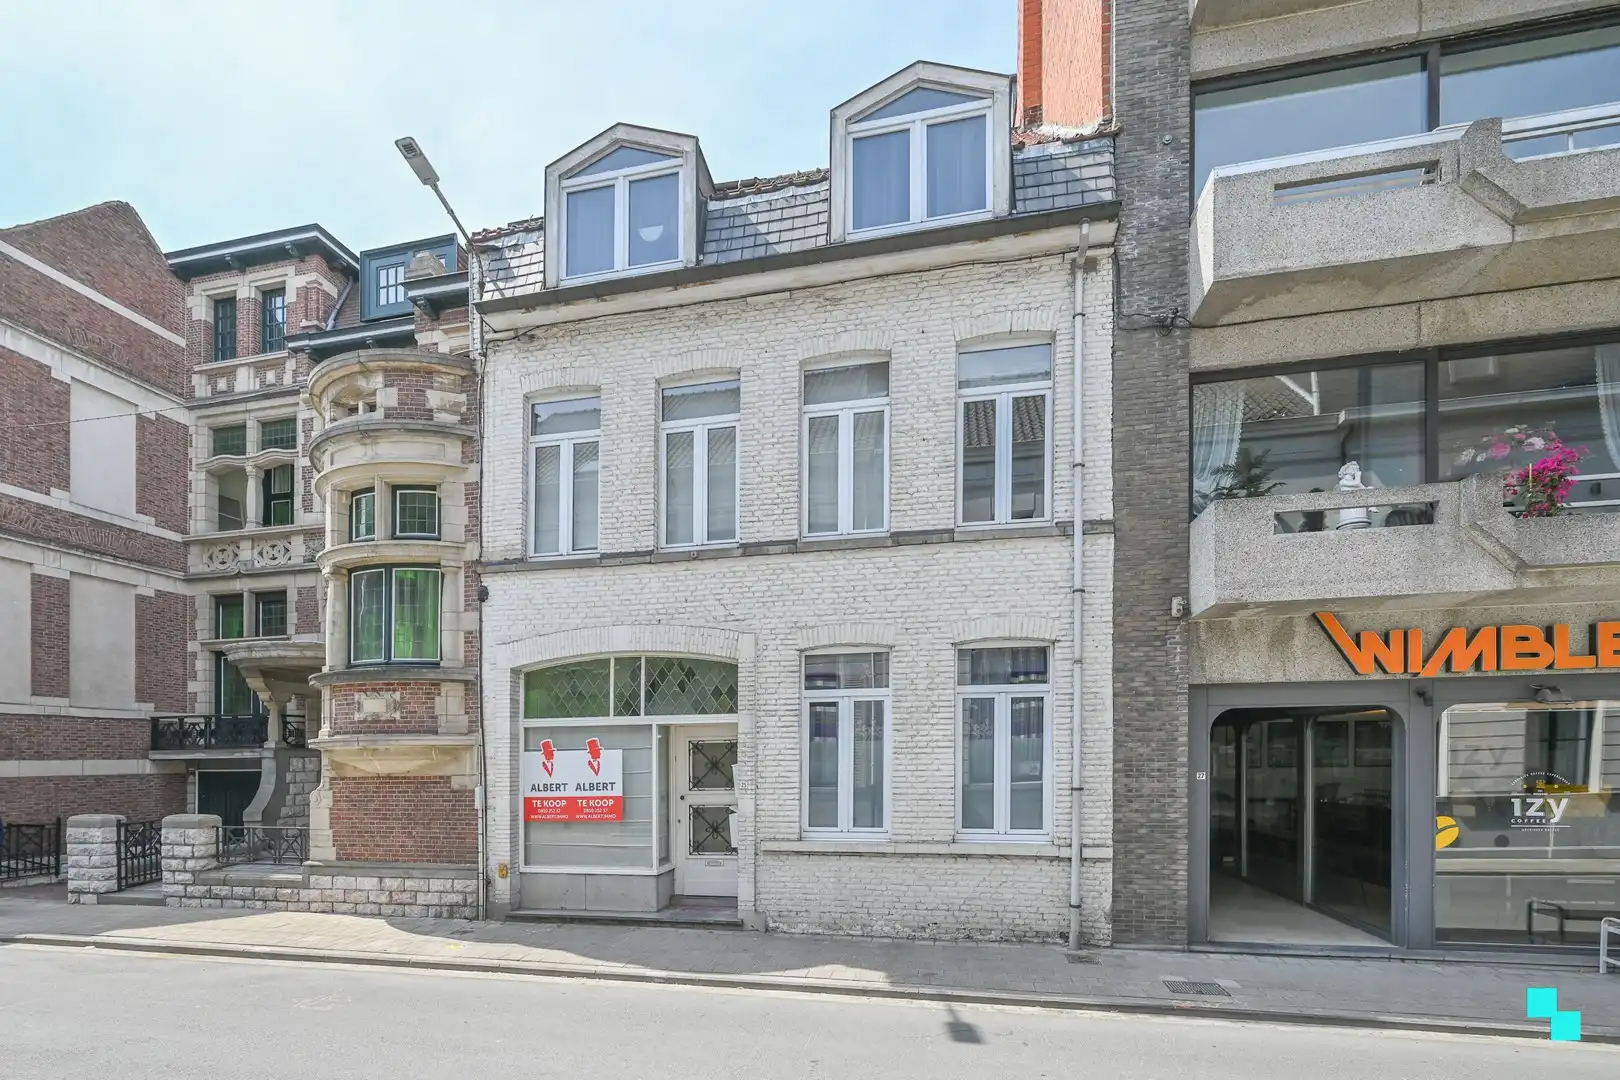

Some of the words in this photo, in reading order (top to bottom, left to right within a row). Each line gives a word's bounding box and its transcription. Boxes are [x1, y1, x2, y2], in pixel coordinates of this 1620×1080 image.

[1311, 611, 1620, 677] WIMBLE
[530, 783, 568, 792] ALBERT
[575, 782, 616, 792] ALBERT
[532, 799, 542, 808] TE
[543, 799, 567, 808] KOOP
[577, 799, 588, 807] TE
[589, 799, 614, 807] KOOP
